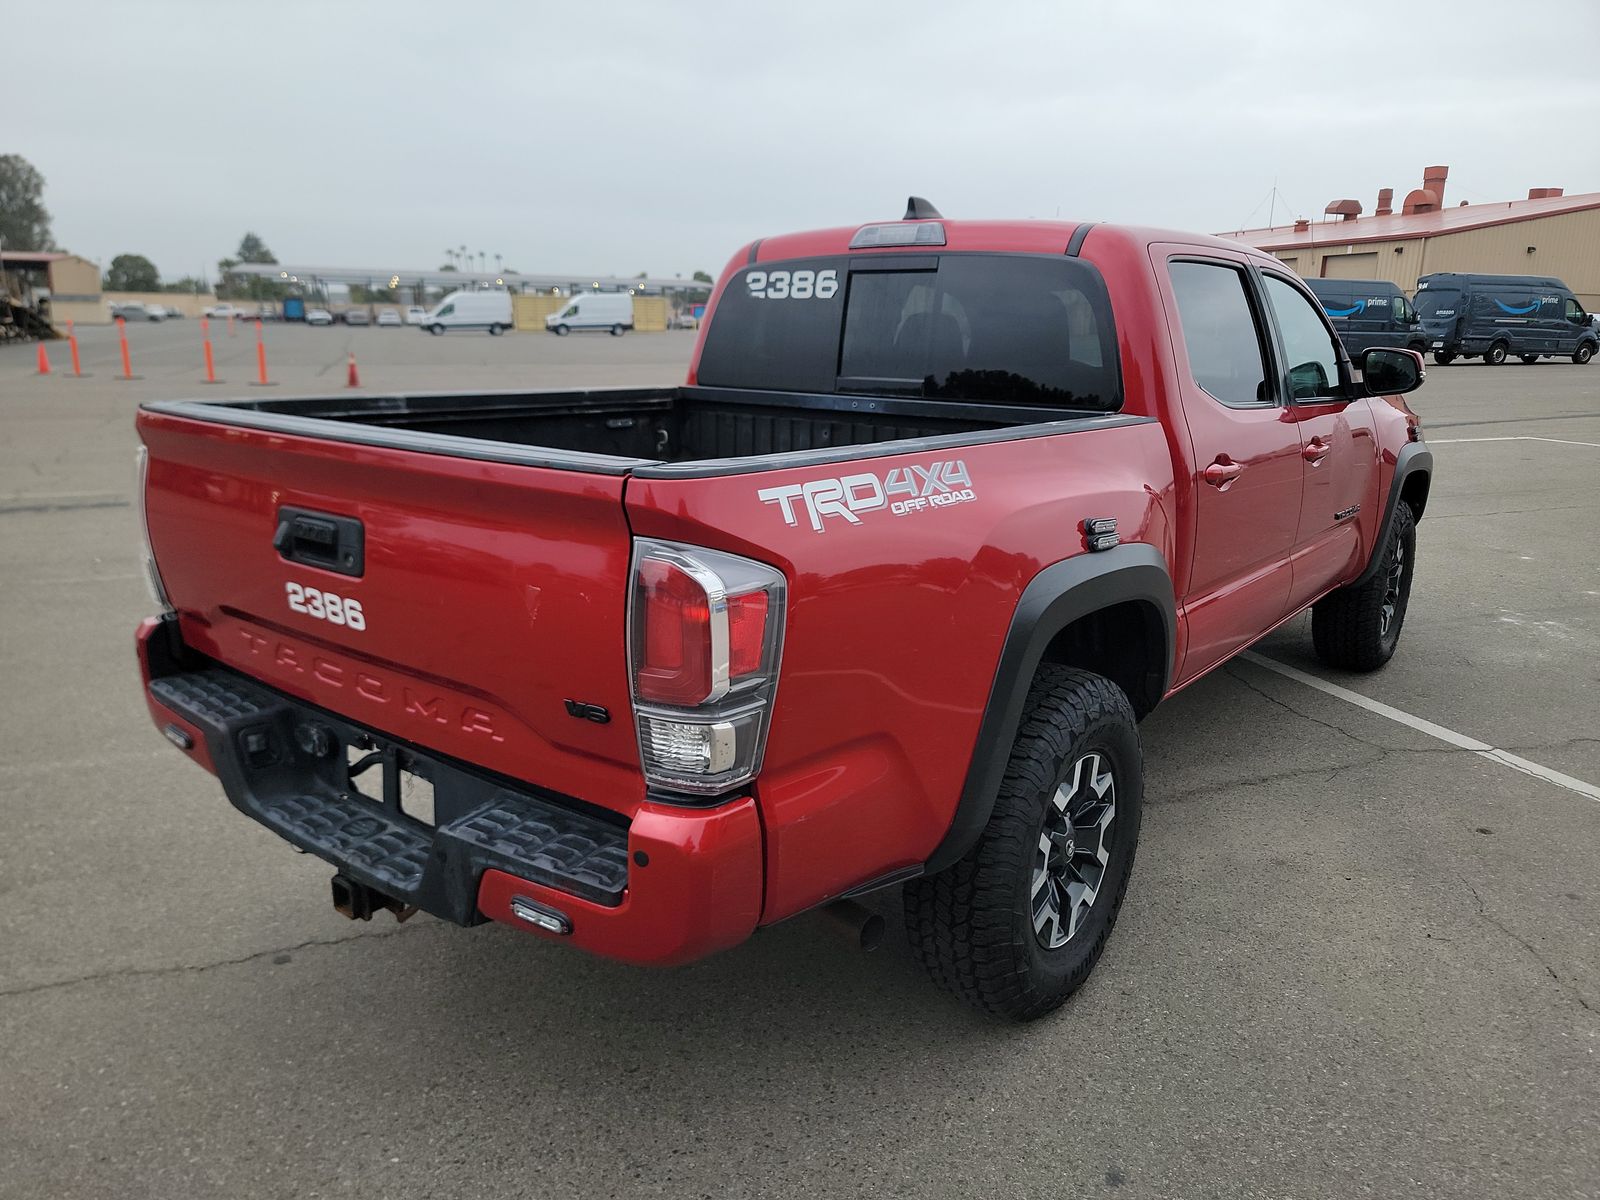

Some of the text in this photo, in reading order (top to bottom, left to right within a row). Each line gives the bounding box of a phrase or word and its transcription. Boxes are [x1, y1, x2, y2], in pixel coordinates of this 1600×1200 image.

[746, 270, 839, 299] 2386
[1367, 297, 1388, 307] prime
[1541, 296, 1559, 305] prime
[757, 460, 972, 533] TRD 4X4
[890, 489, 978, 517] OFF ROAD
[285, 582, 367, 632] 2386
[240, 631, 504, 742] TACOMA
[563, 698, 612, 725] V6
